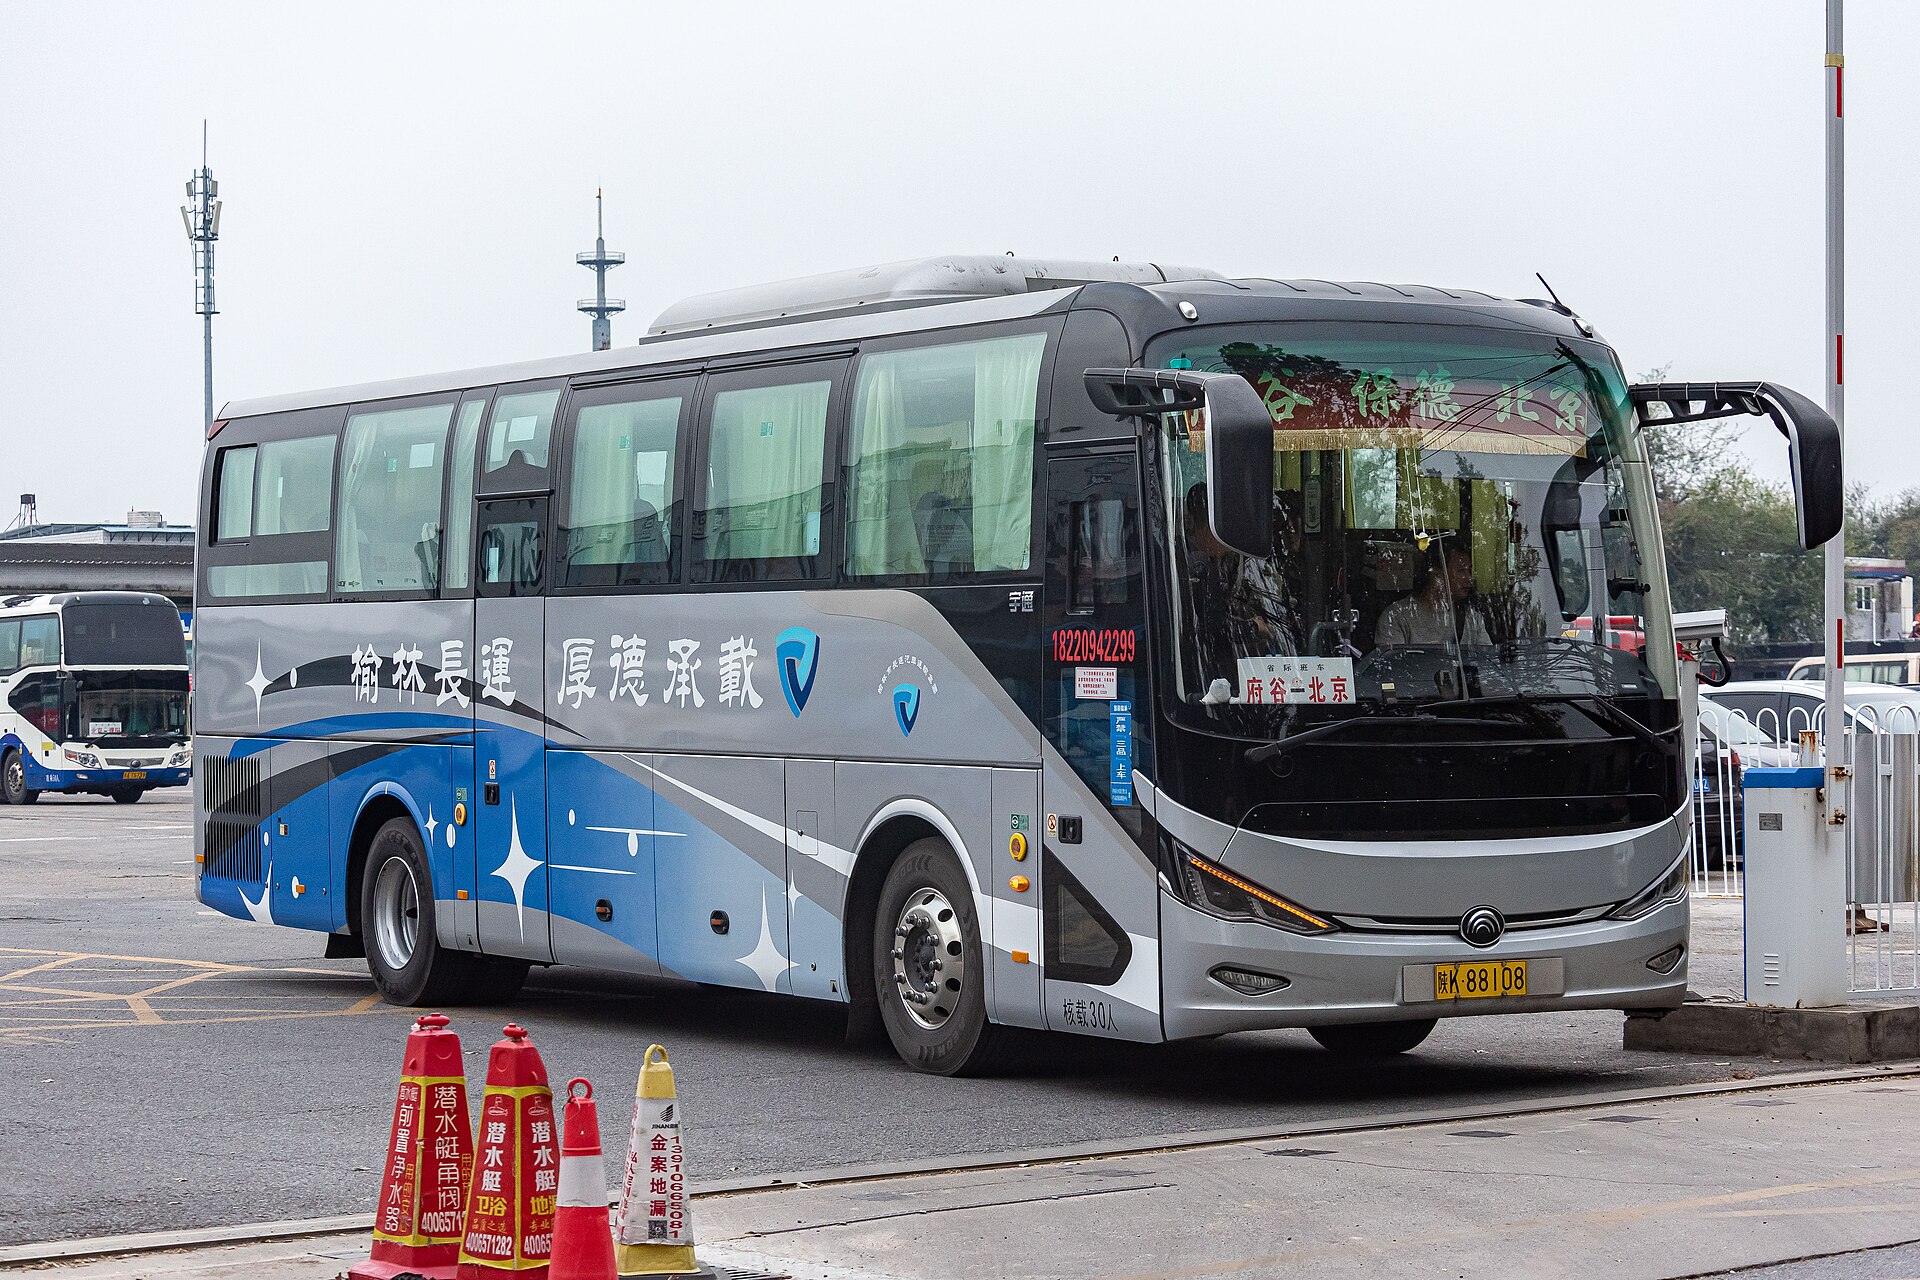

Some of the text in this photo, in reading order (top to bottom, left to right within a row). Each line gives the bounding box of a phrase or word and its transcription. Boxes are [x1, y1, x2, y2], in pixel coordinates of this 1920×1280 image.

[1495, 375, 1586, 432] 北京
[1009, 590, 1034, 613] 宇通
[1052, 629, 1135, 662] 18220942299
[1267, 663, 1325, 673] 省际班车
[1063, 998, 1119, 1032] 核载30人
[384, 1103, 414, 1232] 前置净水器
[433, 1086, 461, 1210] 潜水艇角阀
[481, 1121, 507, 1192] 潜水艇
[531, 1121, 557, 1192] 潜水艇
[649, 1133, 668, 1217] 金案地漏
[475, 1195, 507, 1217] 卫浴
[465, 1231, 513, 1256] 4006571282
